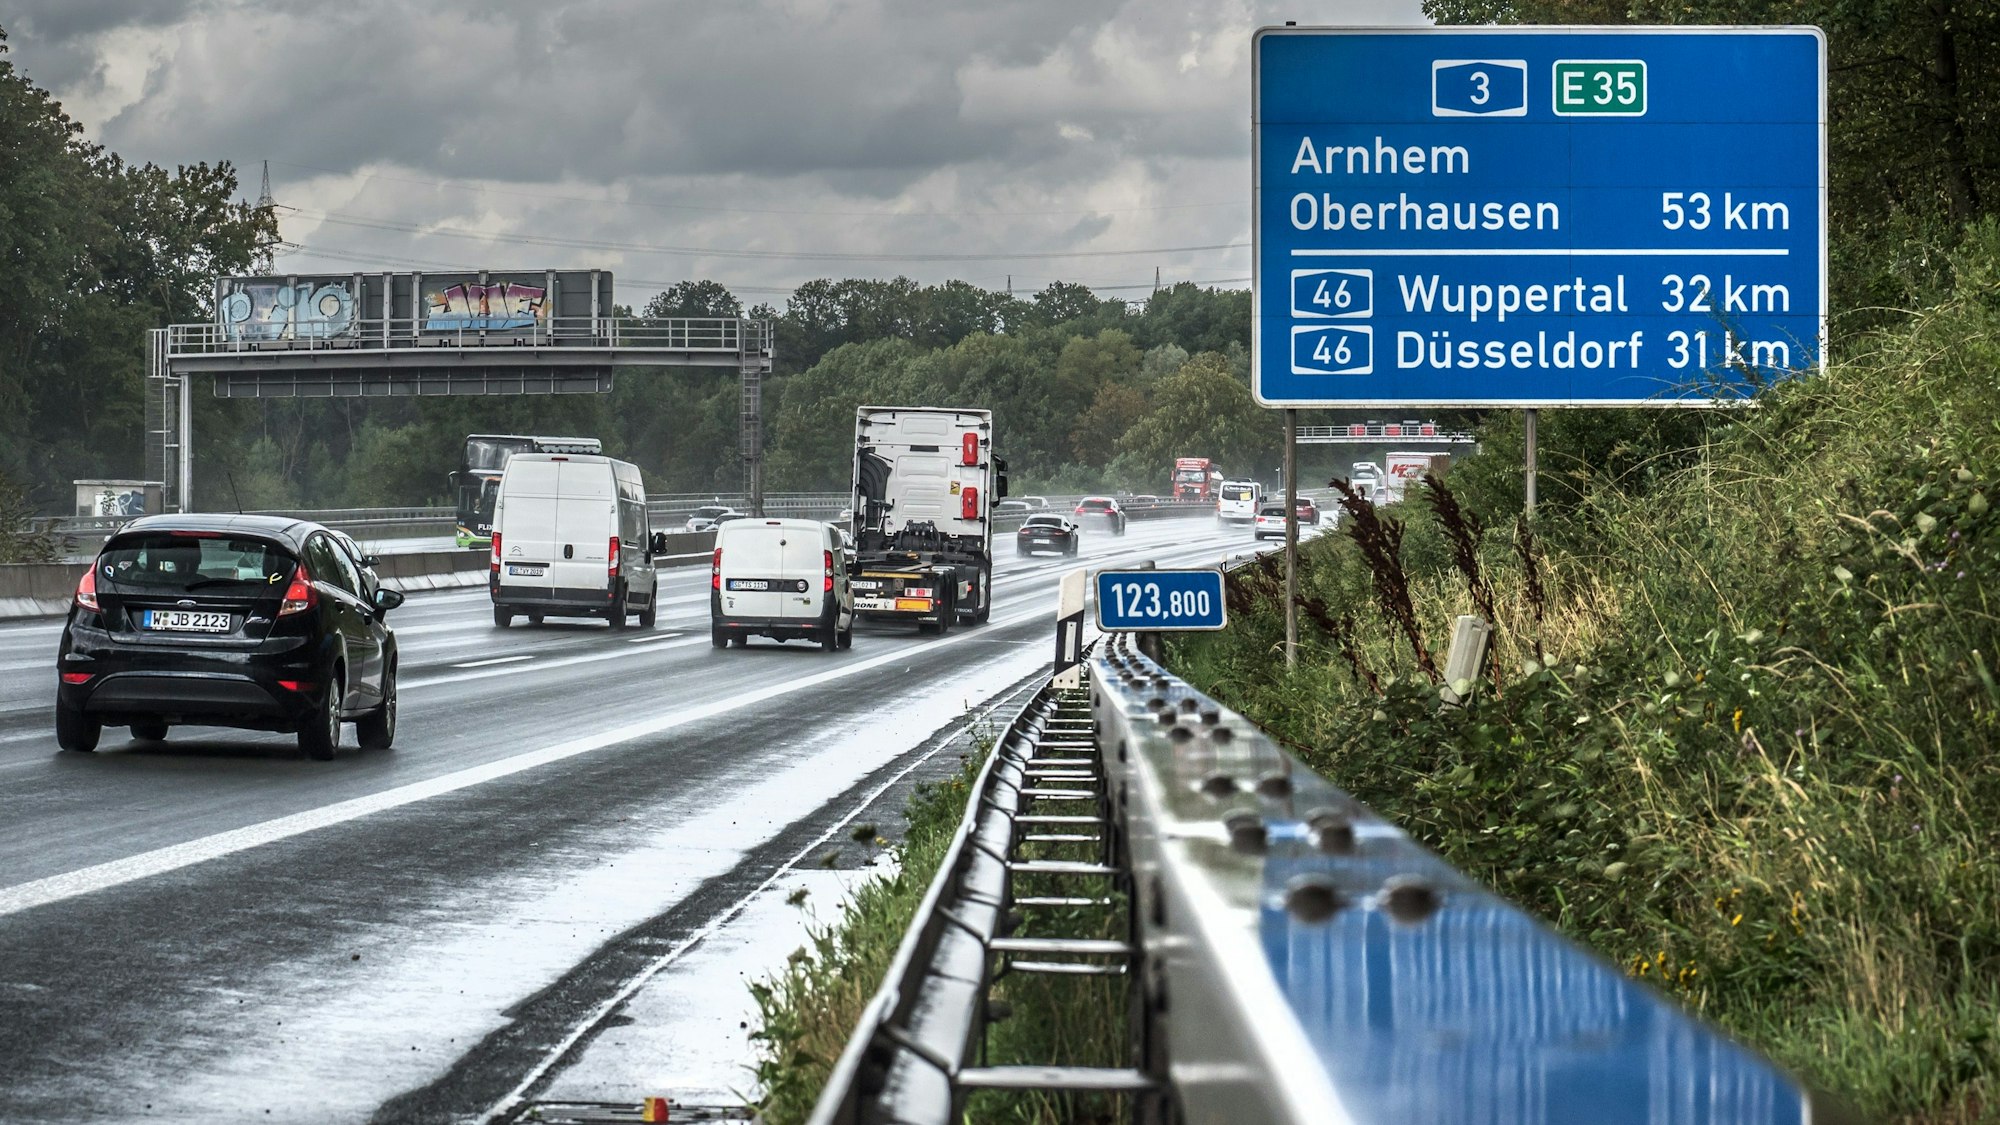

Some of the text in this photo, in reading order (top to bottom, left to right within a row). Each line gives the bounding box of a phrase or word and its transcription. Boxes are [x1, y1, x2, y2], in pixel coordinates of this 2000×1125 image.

[1471, 72, 1490, 105] 3
[1563, 71, 1637, 105] E 35
[1291, 136, 1469, 174] Arnhem
[1290, 192, 1789, 230] Oberhausen 53 km
[1312, 279, 1352, 308] 46
[1397, 274, 1789, 322] Wuppertal 32 km
[1312, 336, 1352, 364] 46
[1397, 331, 1789, 368] Düsseldorf 31 km
[1111, 582, 1210, 620] 123,800
[153, 612, 228, 628] W JB 2123
